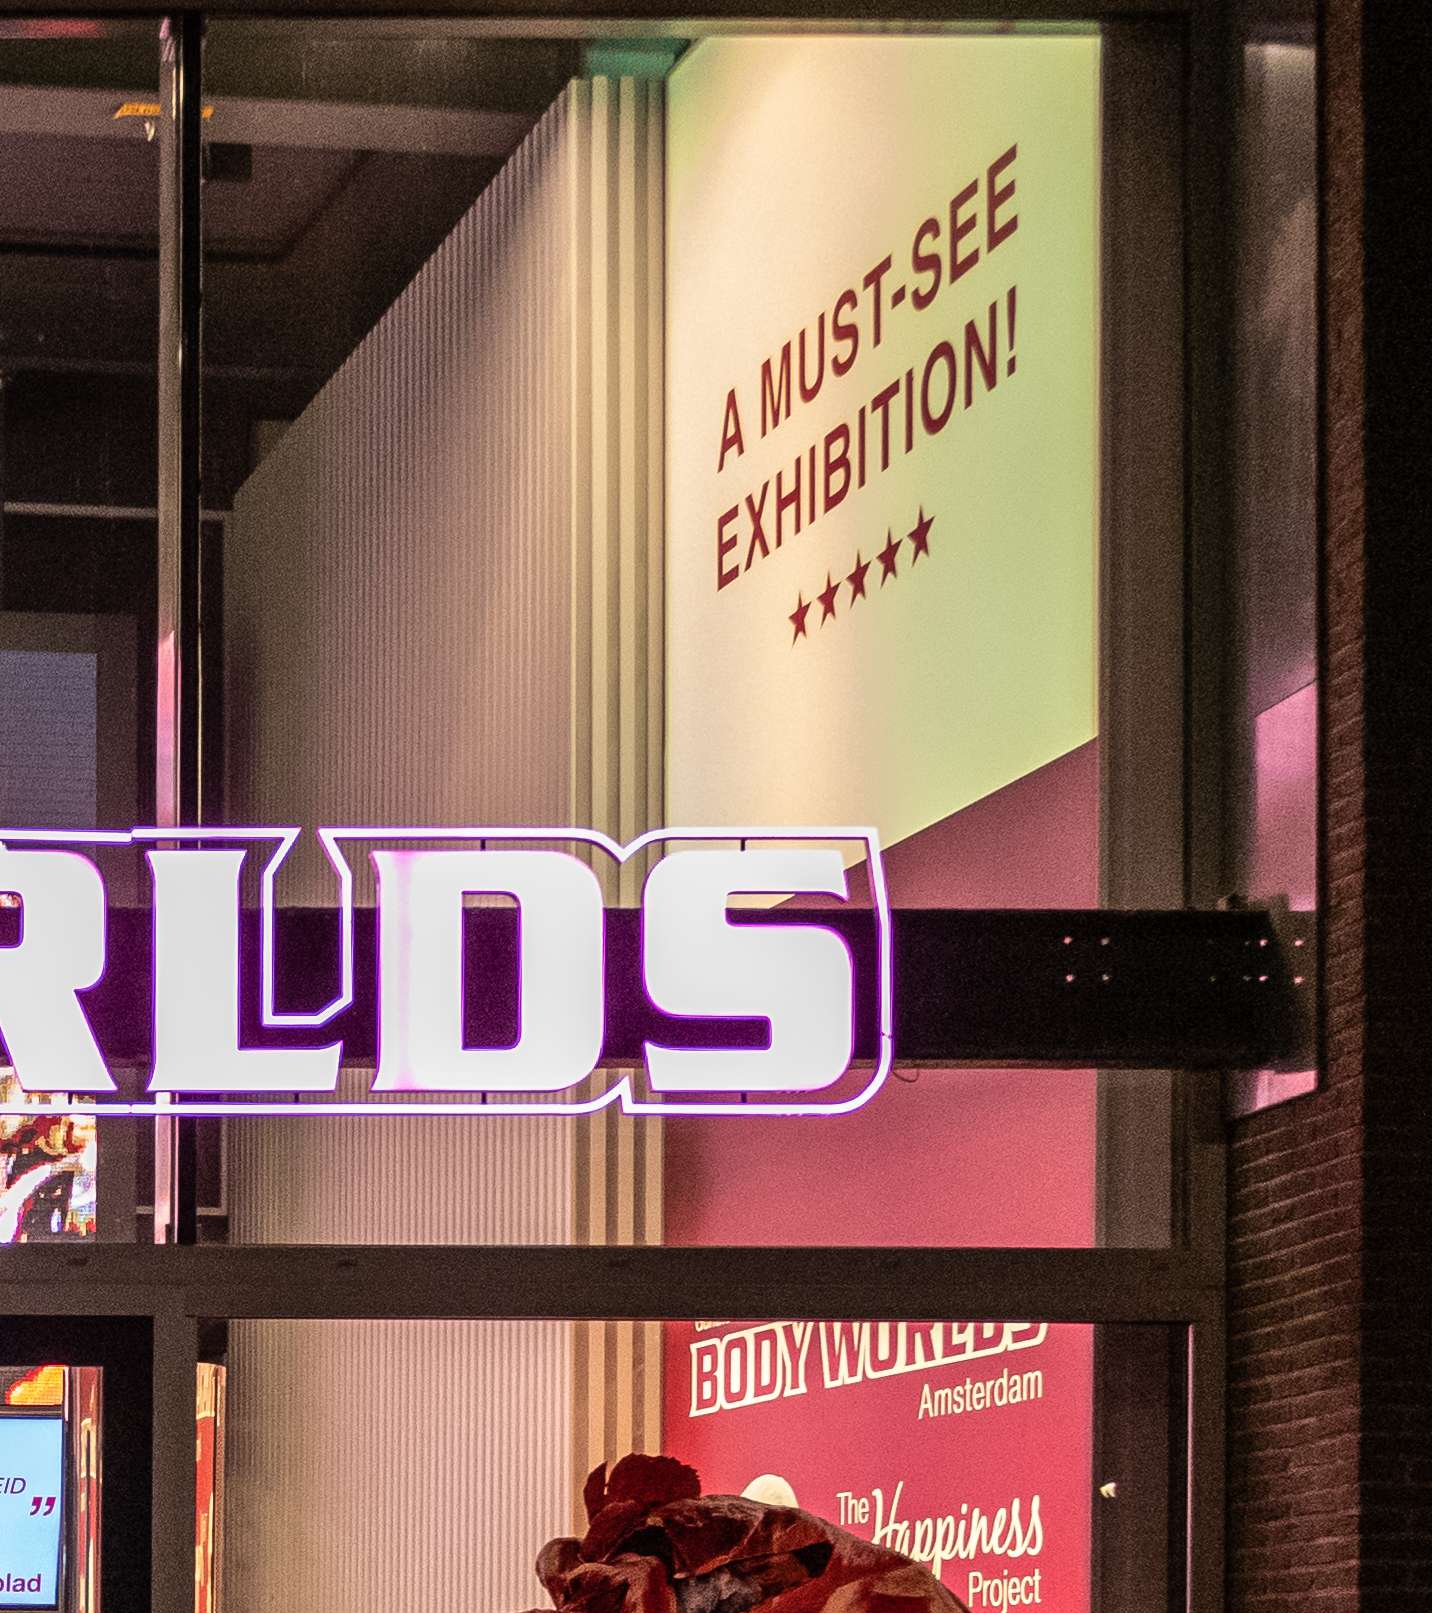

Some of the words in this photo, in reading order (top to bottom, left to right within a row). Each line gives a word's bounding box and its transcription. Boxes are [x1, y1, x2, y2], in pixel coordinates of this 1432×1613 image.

[717, 387, 745, 474] A
[761, 143, 1019, 438] MUST-SEE
[717, 285, 1017, 592] EXHIBITION!
[689, 1322, 814, 1417] BODY
[918, 1368, 1043, 1420] Amsterdam
[836, 1491, 870, 1526] The
[872, 1481, 1044, 1582] Happiness
